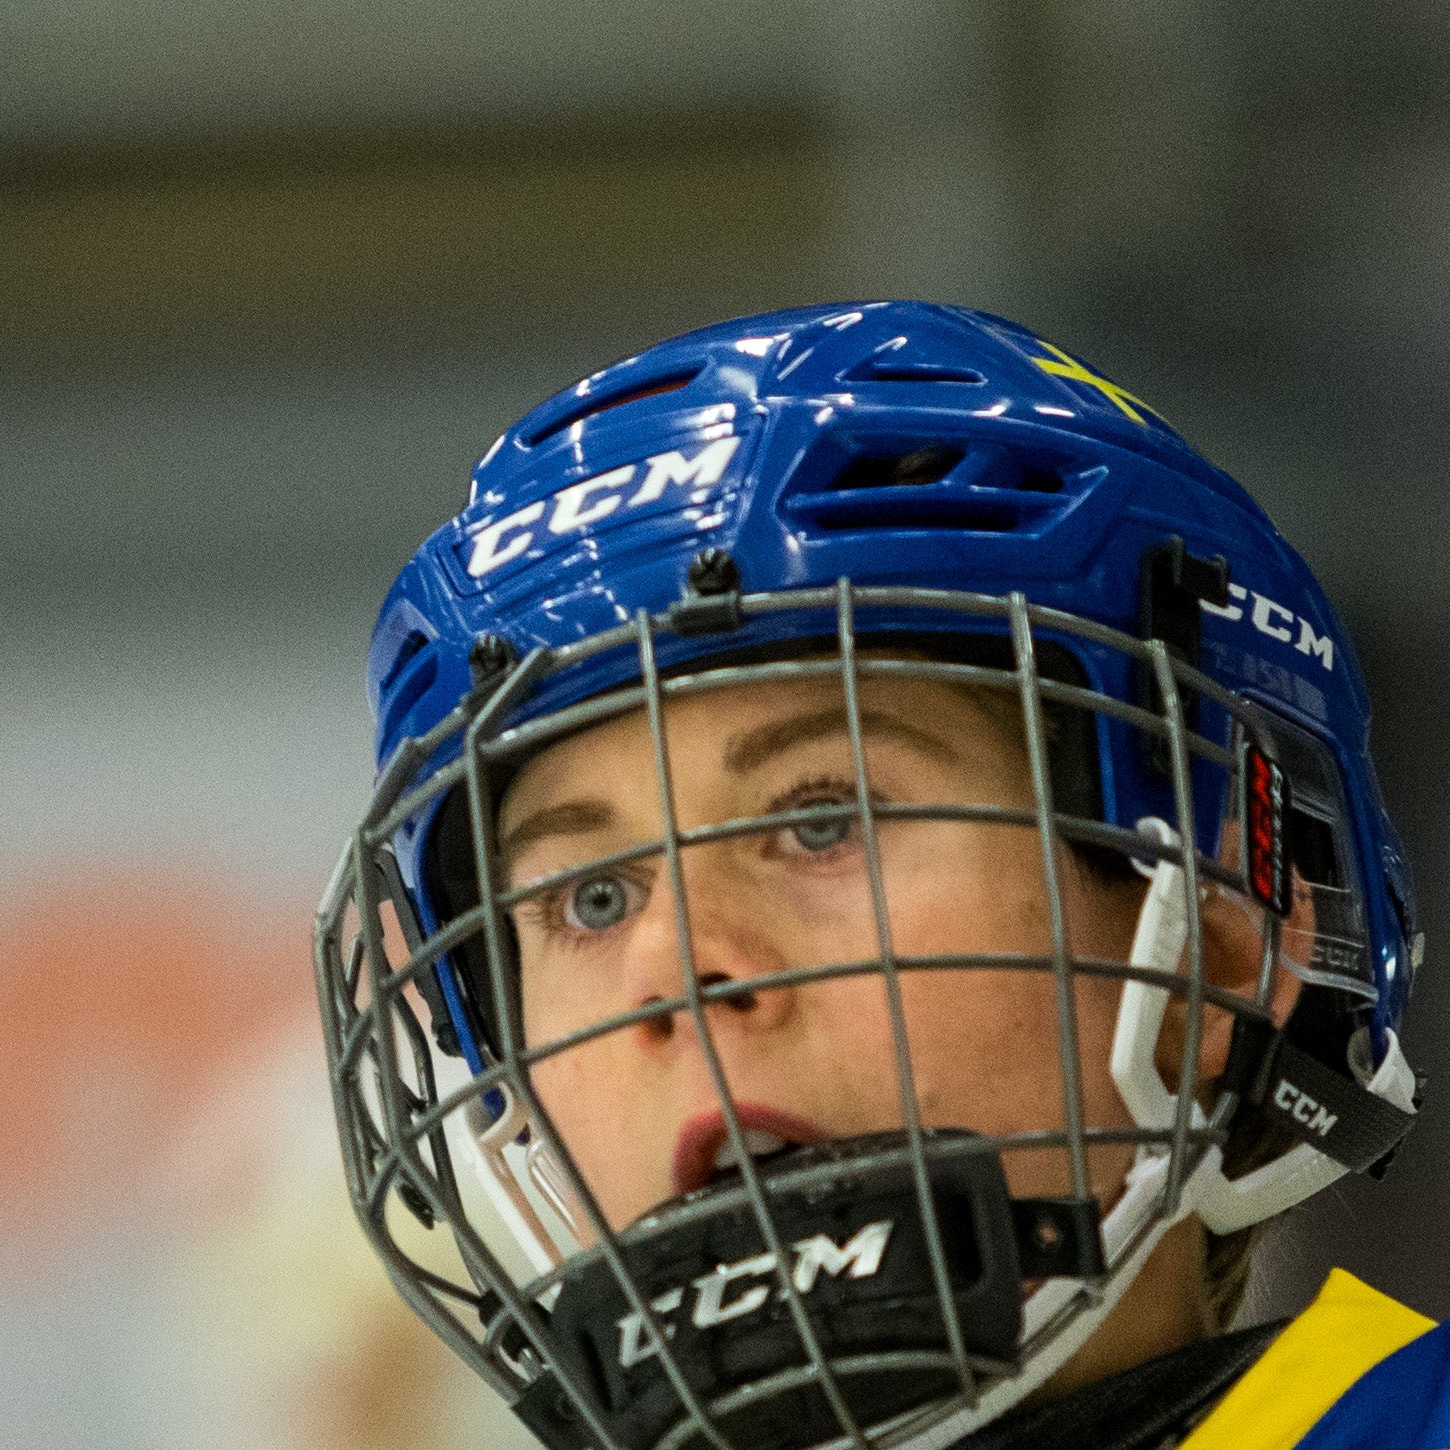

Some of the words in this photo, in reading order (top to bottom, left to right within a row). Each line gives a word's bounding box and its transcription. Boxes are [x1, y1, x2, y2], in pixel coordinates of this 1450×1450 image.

[466, 436, 740, 577] CCM
[1197, 582, 1334, 672] CCM
[1274, 1078, 1339, 1137] CCM
[617, 1219, 895, 1368] CCM
